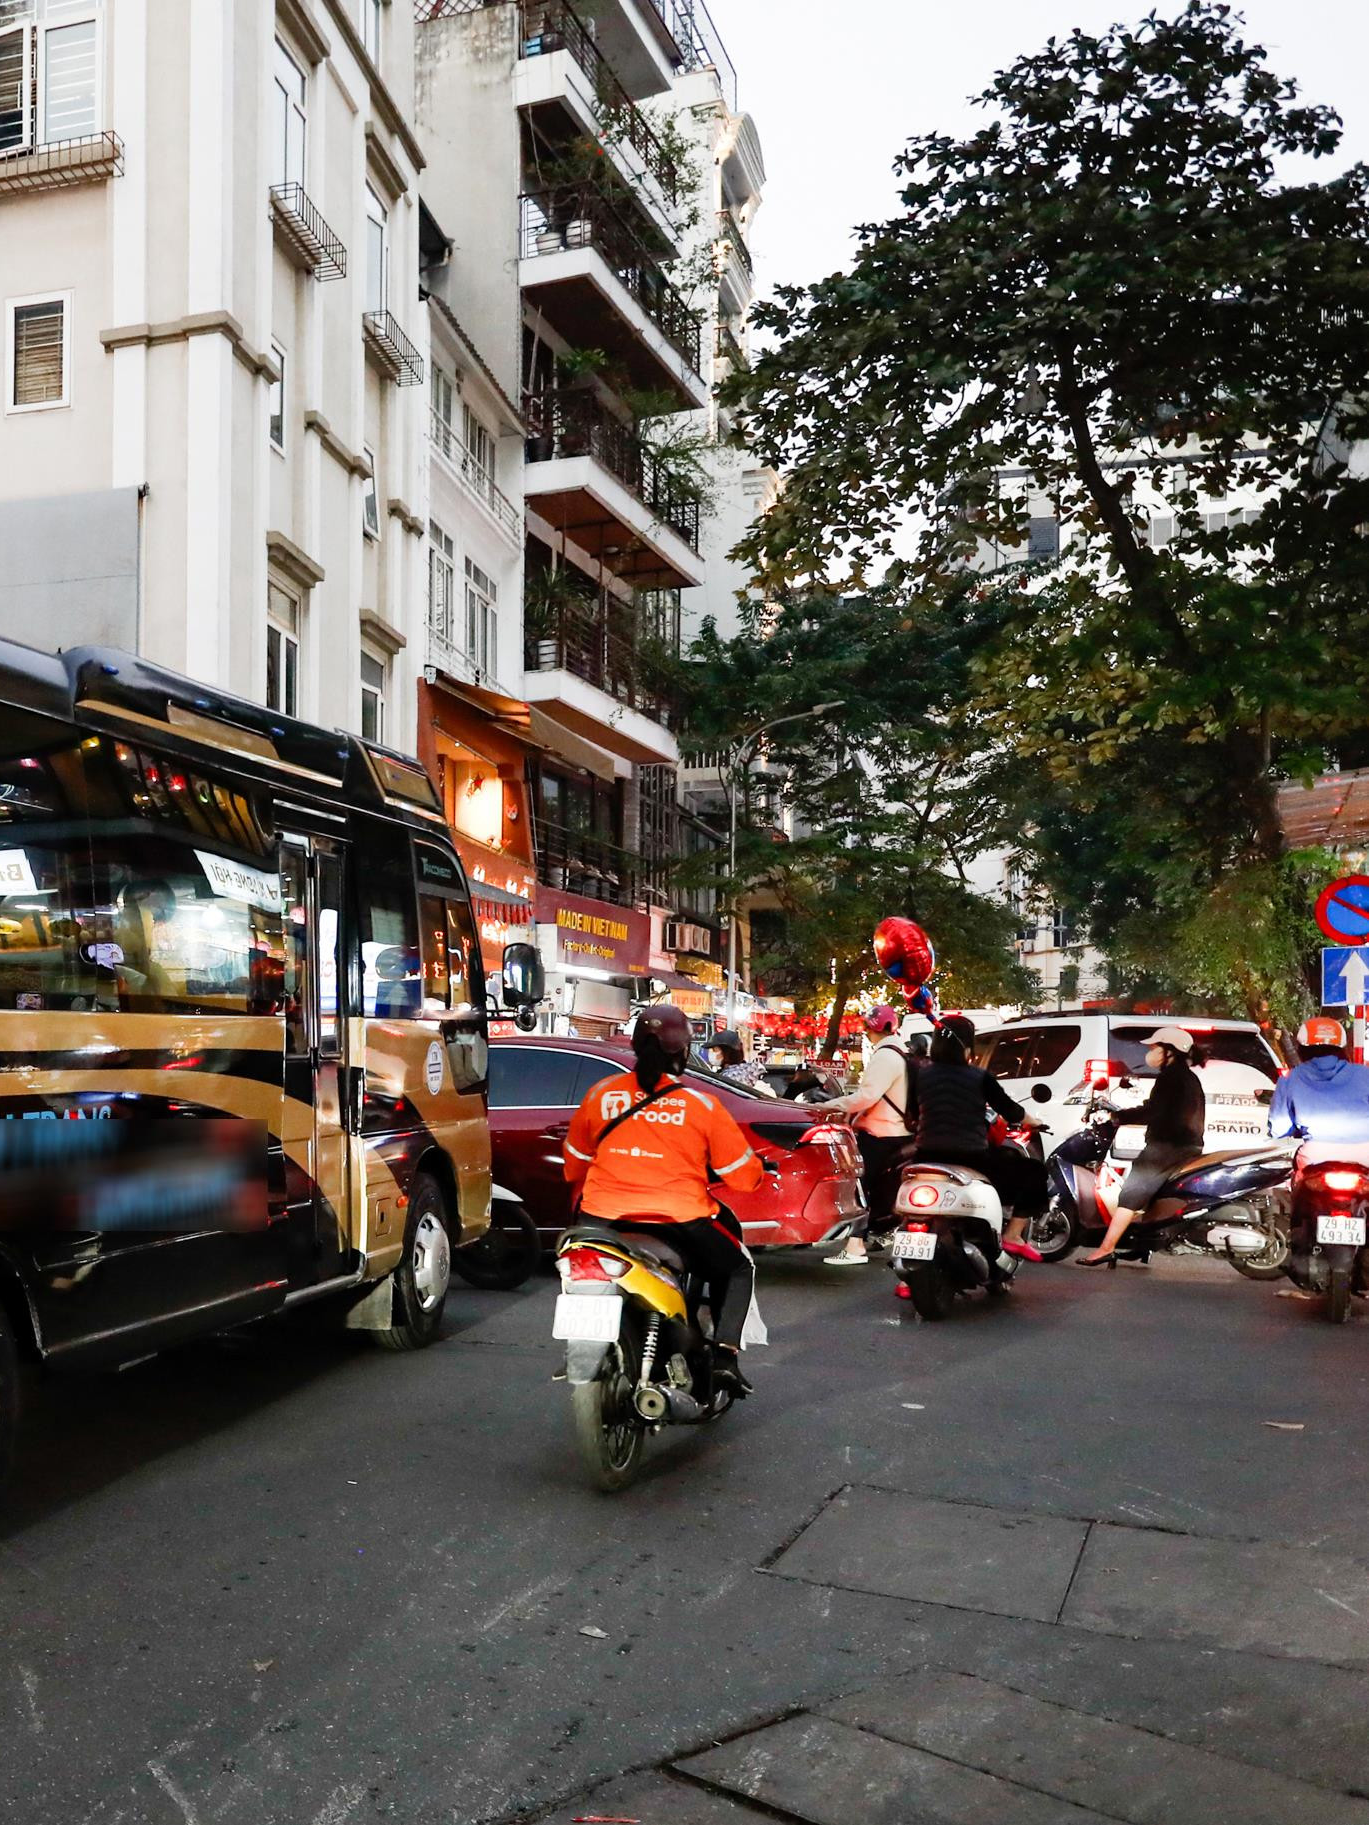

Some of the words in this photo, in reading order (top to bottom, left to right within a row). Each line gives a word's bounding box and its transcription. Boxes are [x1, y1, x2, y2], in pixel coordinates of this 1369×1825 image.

[556, 908, 583, 931] MADE
[582, 914, 592, 933] IN
[634, 1091, 687, 1109] Spee
[1215, 1097, 1259, 1106] PRADO
[1207, 1123, 1261, 1135] PRADO
[893, 1245, 931, 1259] 033.91
